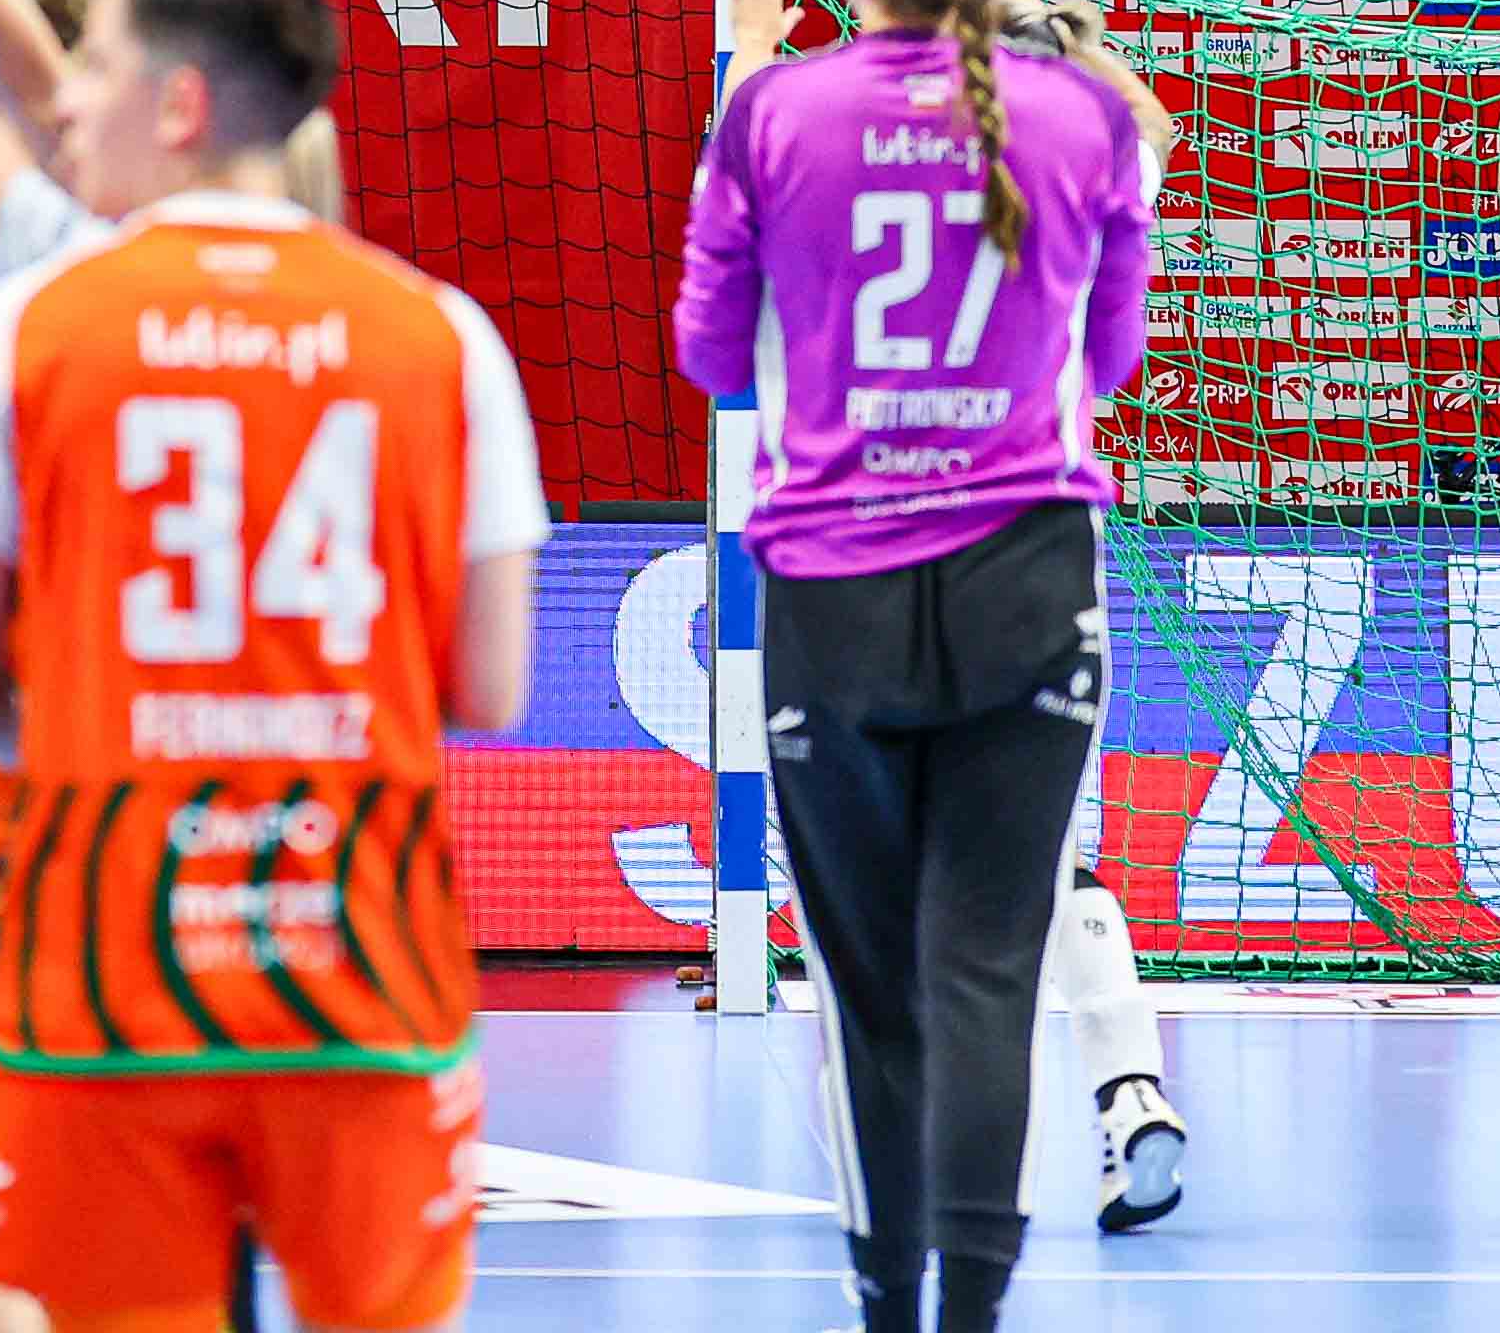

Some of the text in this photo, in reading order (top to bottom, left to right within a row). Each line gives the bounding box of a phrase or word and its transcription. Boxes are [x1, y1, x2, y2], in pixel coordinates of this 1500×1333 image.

[1206, 39, 1252, 52] GRUPA
[1208, 52, 1261, 66] UXMED
[1188, 134, 1250, 153] ZPRP
[1326, 131, 1403, 149] ORLEN
[1326, 241, 1404, 259] ORLEN
[850, 190, 1008, 373] 27
[1147, 310, 1181, 325] LEN
[1336, 311, 1394, 325] ORLEN
[1187, 384, 1250, 405] ZPRP
[1322, 382, 1402, 401] ORLEN
[1323, 482, 1402, 500] ORLEN
[114, 397, 387, 665] 34
